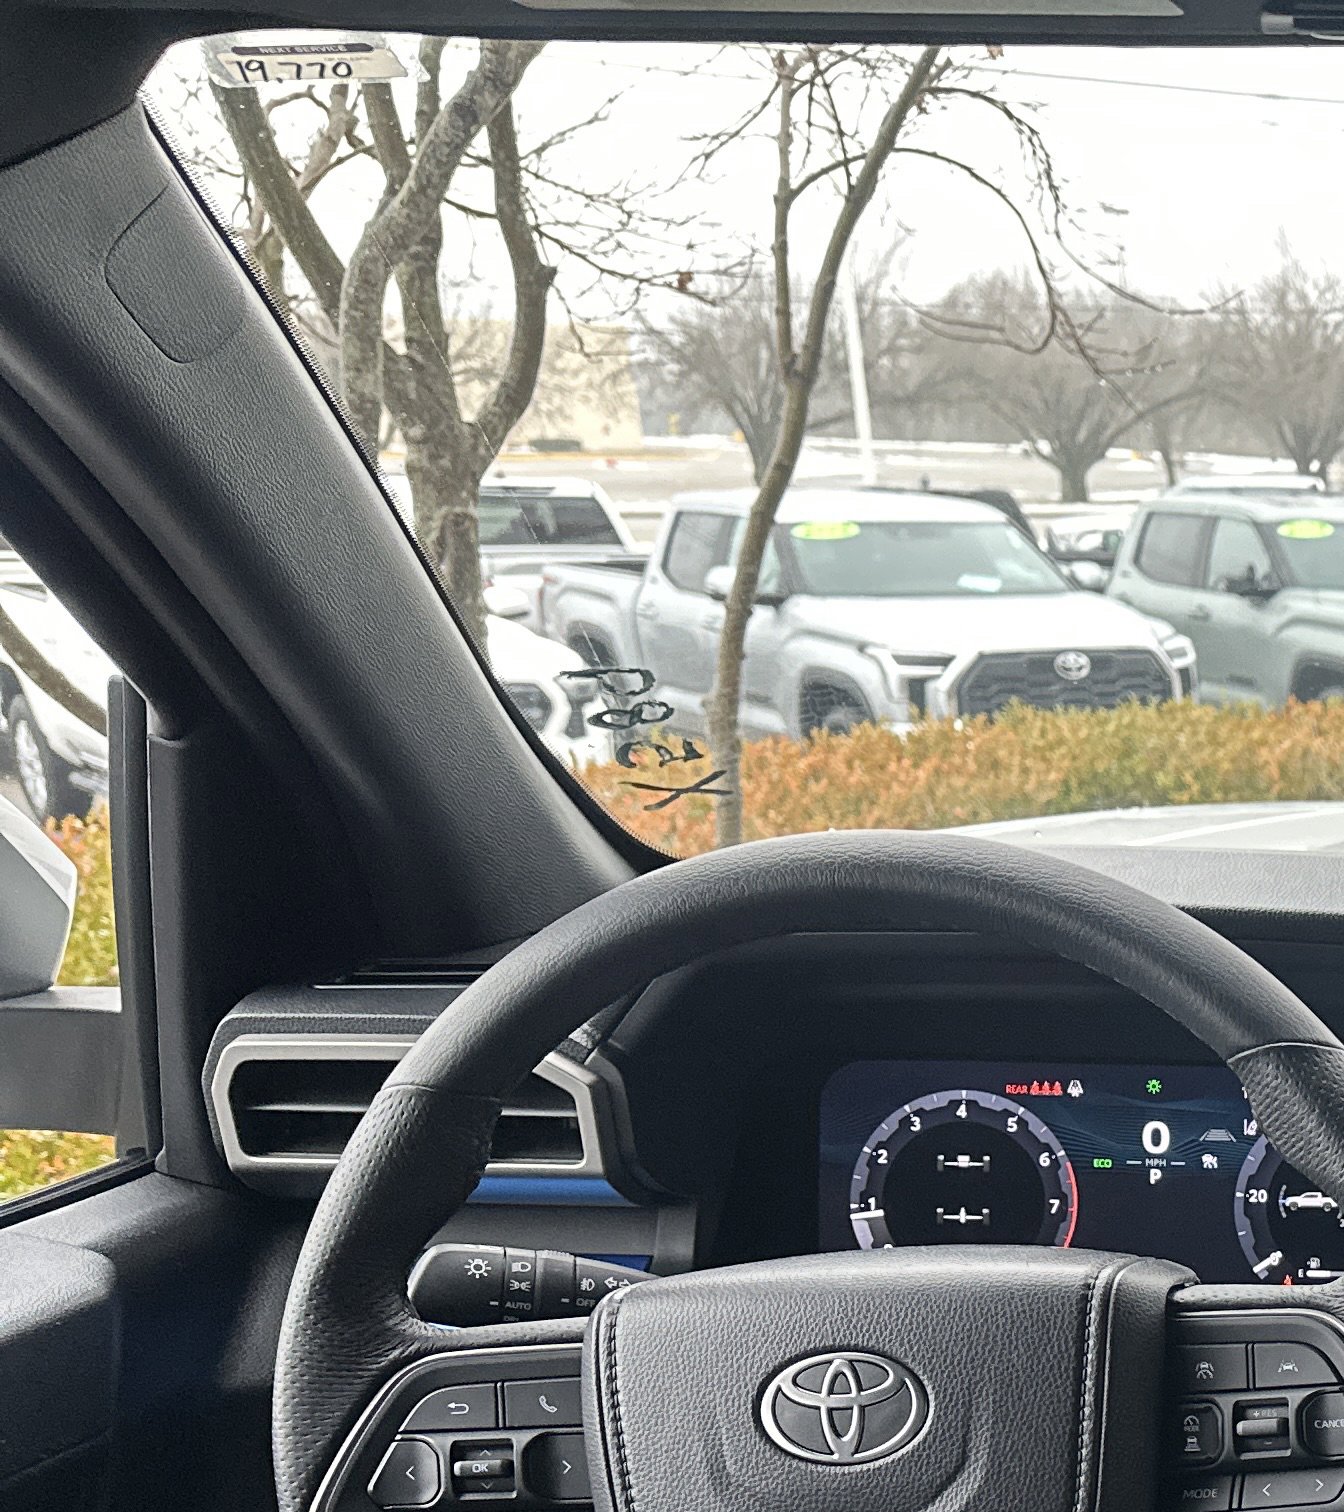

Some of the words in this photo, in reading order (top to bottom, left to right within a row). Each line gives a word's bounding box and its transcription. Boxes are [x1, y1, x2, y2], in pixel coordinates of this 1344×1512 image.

[259, 46, 292, 54] NEXT
[294, 45, 348, 53] SERVICE
[1005, 1084, 1029, 1095] REAR
[955, 1104, 968, 1119] 4
[910, 1116, 921, 1132] 3
[1006, 1116, 1018, 1133] 5
[1142, 1120, 1171, 1154] 0
[877, 1149, 888, 1164] 2
[1038, 1152, 1050, 1167] 6
[1093, 1158, 1112, 1168] ECO
[1145, 1158, 1167, 1167] MPH
[1149, 1168, 1162, 1185] P
[1249, 1189, 1268, 1203] 20
[867, 1196, 876, 1211] 1
[1049, 1199, 1060, 1214] 7
[505, 1301, 532, 1311] AUTO
[576, 1297, 596, 1308] OFF
[471, 1463, 489, 1473] OK
[1182, 1487, 1219, 1499] MODE
